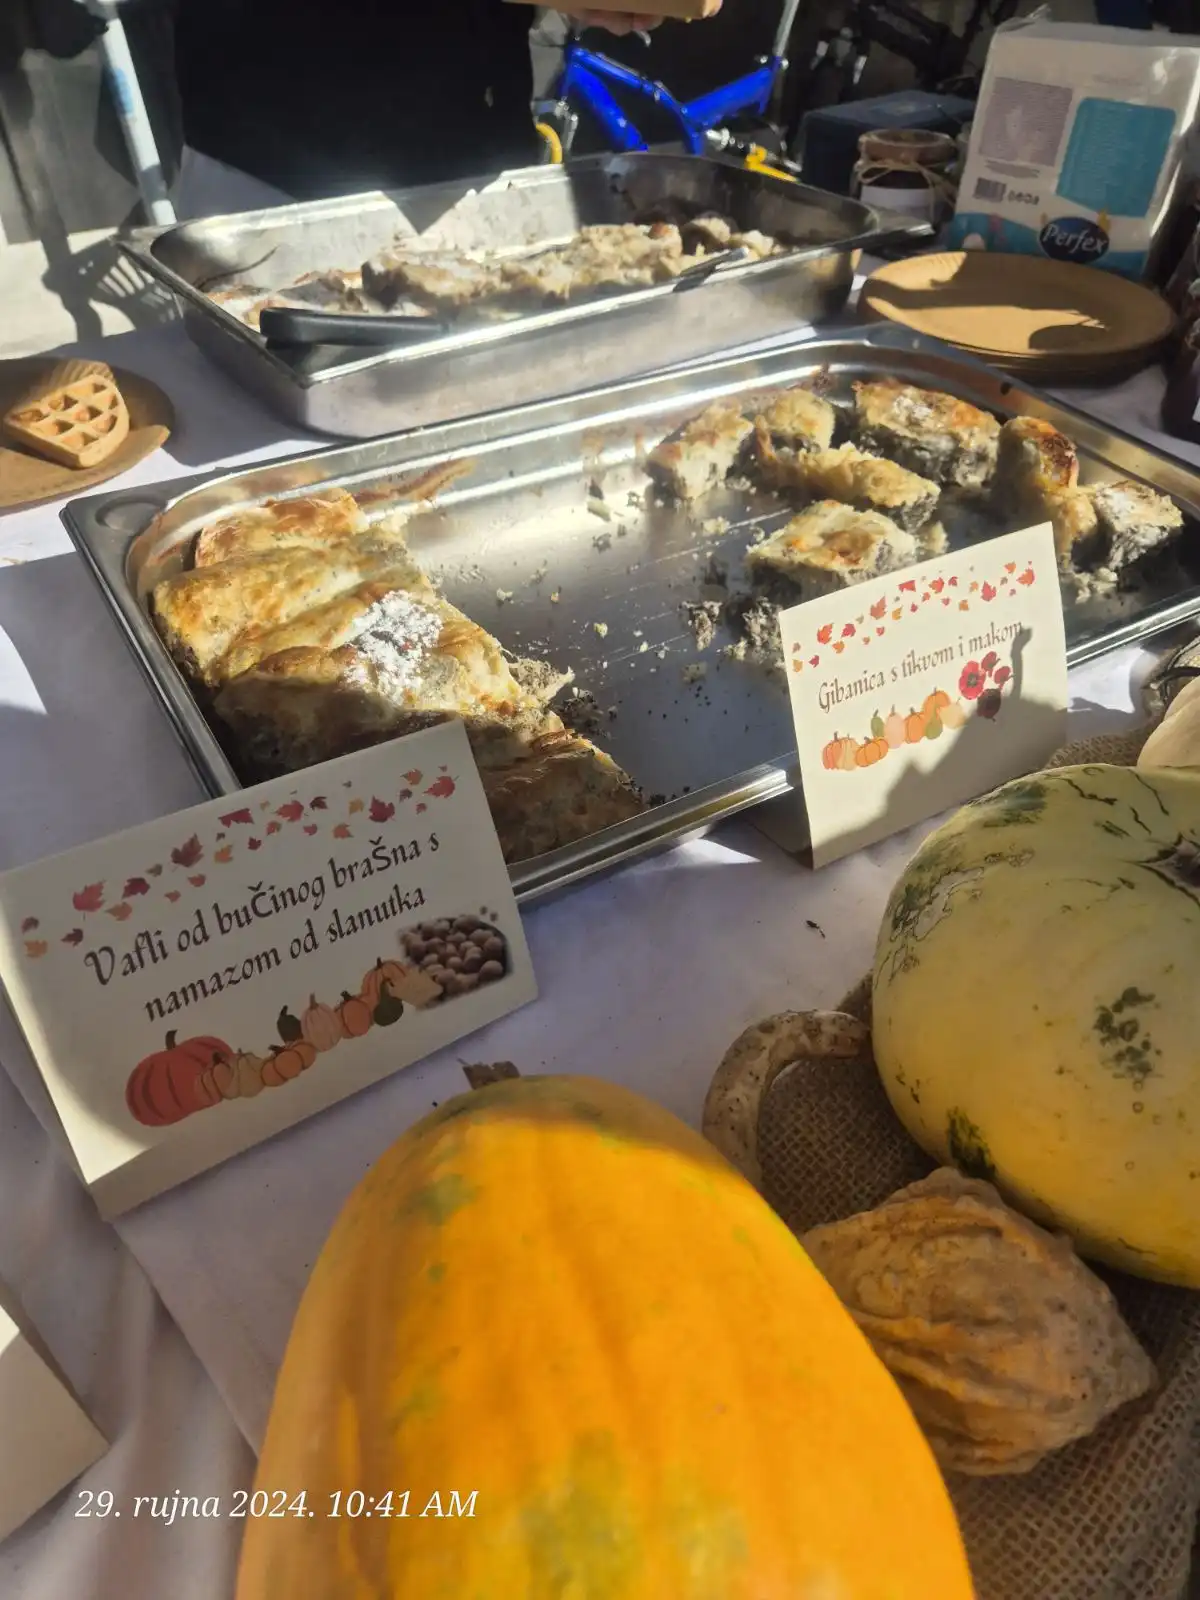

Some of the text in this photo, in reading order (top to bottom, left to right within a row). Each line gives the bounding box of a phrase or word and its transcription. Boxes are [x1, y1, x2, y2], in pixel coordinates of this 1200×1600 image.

[1042, 224, 1107, 254] Perfex
[818, 621, 1025, 713] Gibanica s tikvom i makom
[84, 833, 440, 986] Vafli od buČinog braŠna s
[143, 885, 426, 1023] namazom od slanutka
